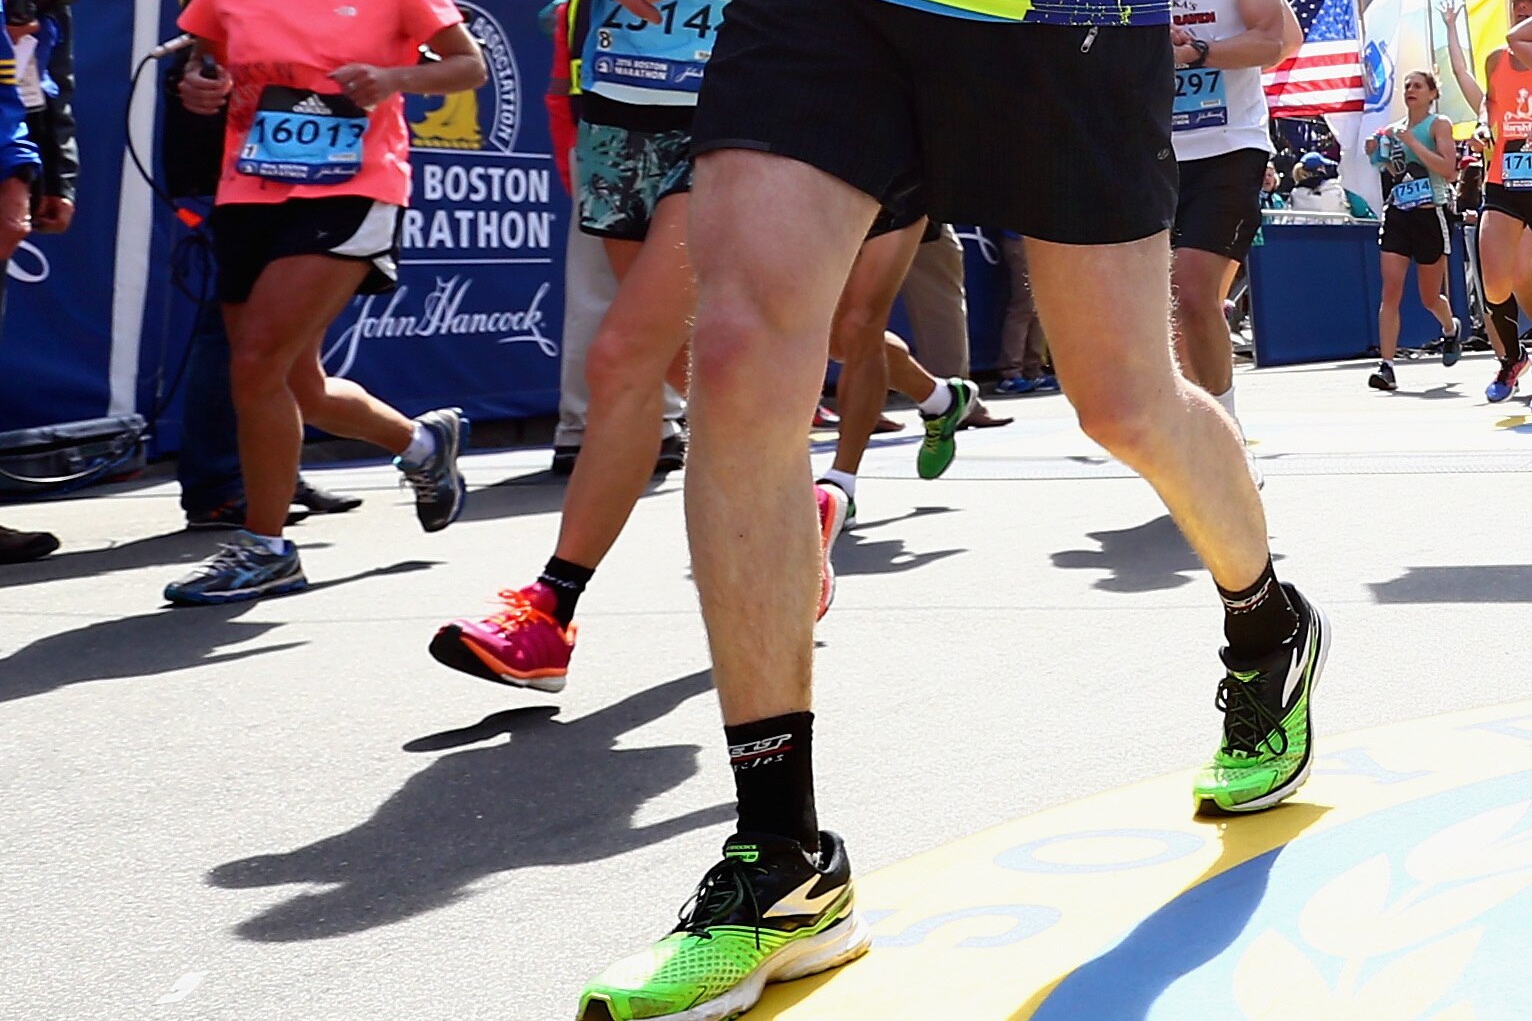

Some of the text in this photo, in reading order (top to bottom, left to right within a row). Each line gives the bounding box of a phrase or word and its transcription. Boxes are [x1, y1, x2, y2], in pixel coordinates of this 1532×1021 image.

[471, 16, 516, 141] ASSOCIATION
[1175, 69, 1221, 97] 297
[423, 162, 550, 204] BOSTON
[401, 209, 551, 249] RATHON
[412, 273, 559, 359] Hancock
